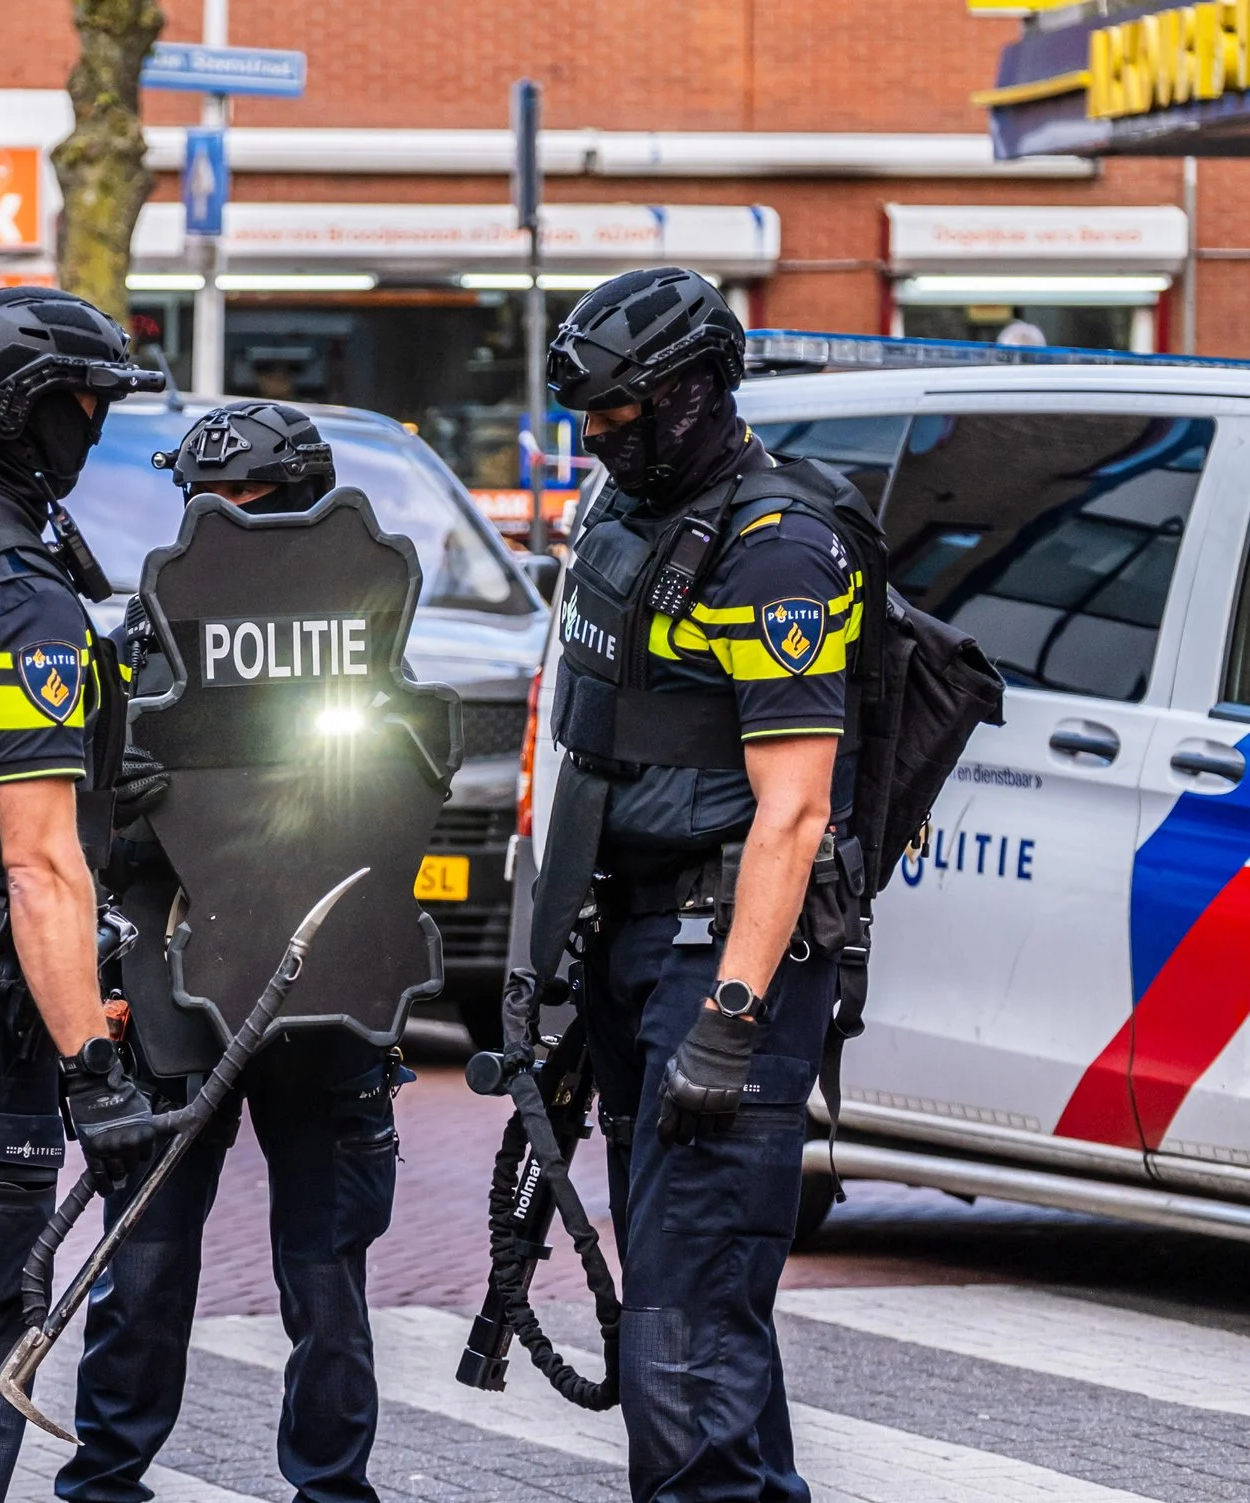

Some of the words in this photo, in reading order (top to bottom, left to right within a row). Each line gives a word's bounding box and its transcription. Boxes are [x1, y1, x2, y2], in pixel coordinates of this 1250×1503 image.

[561, 596, 617, 661] POLITIE
[767, 609, 820, 624] POLITIE
[25, 654, 76, 669] POLITIE
[205, 619, 368, 680] POLITIE
[957, 765, 972, 781] en
[973, 763, 1032, 788] dienstbaar
[901, 828, 1036, 888] OLITIE
[17, 1145, 55, 1159] POLITIE
